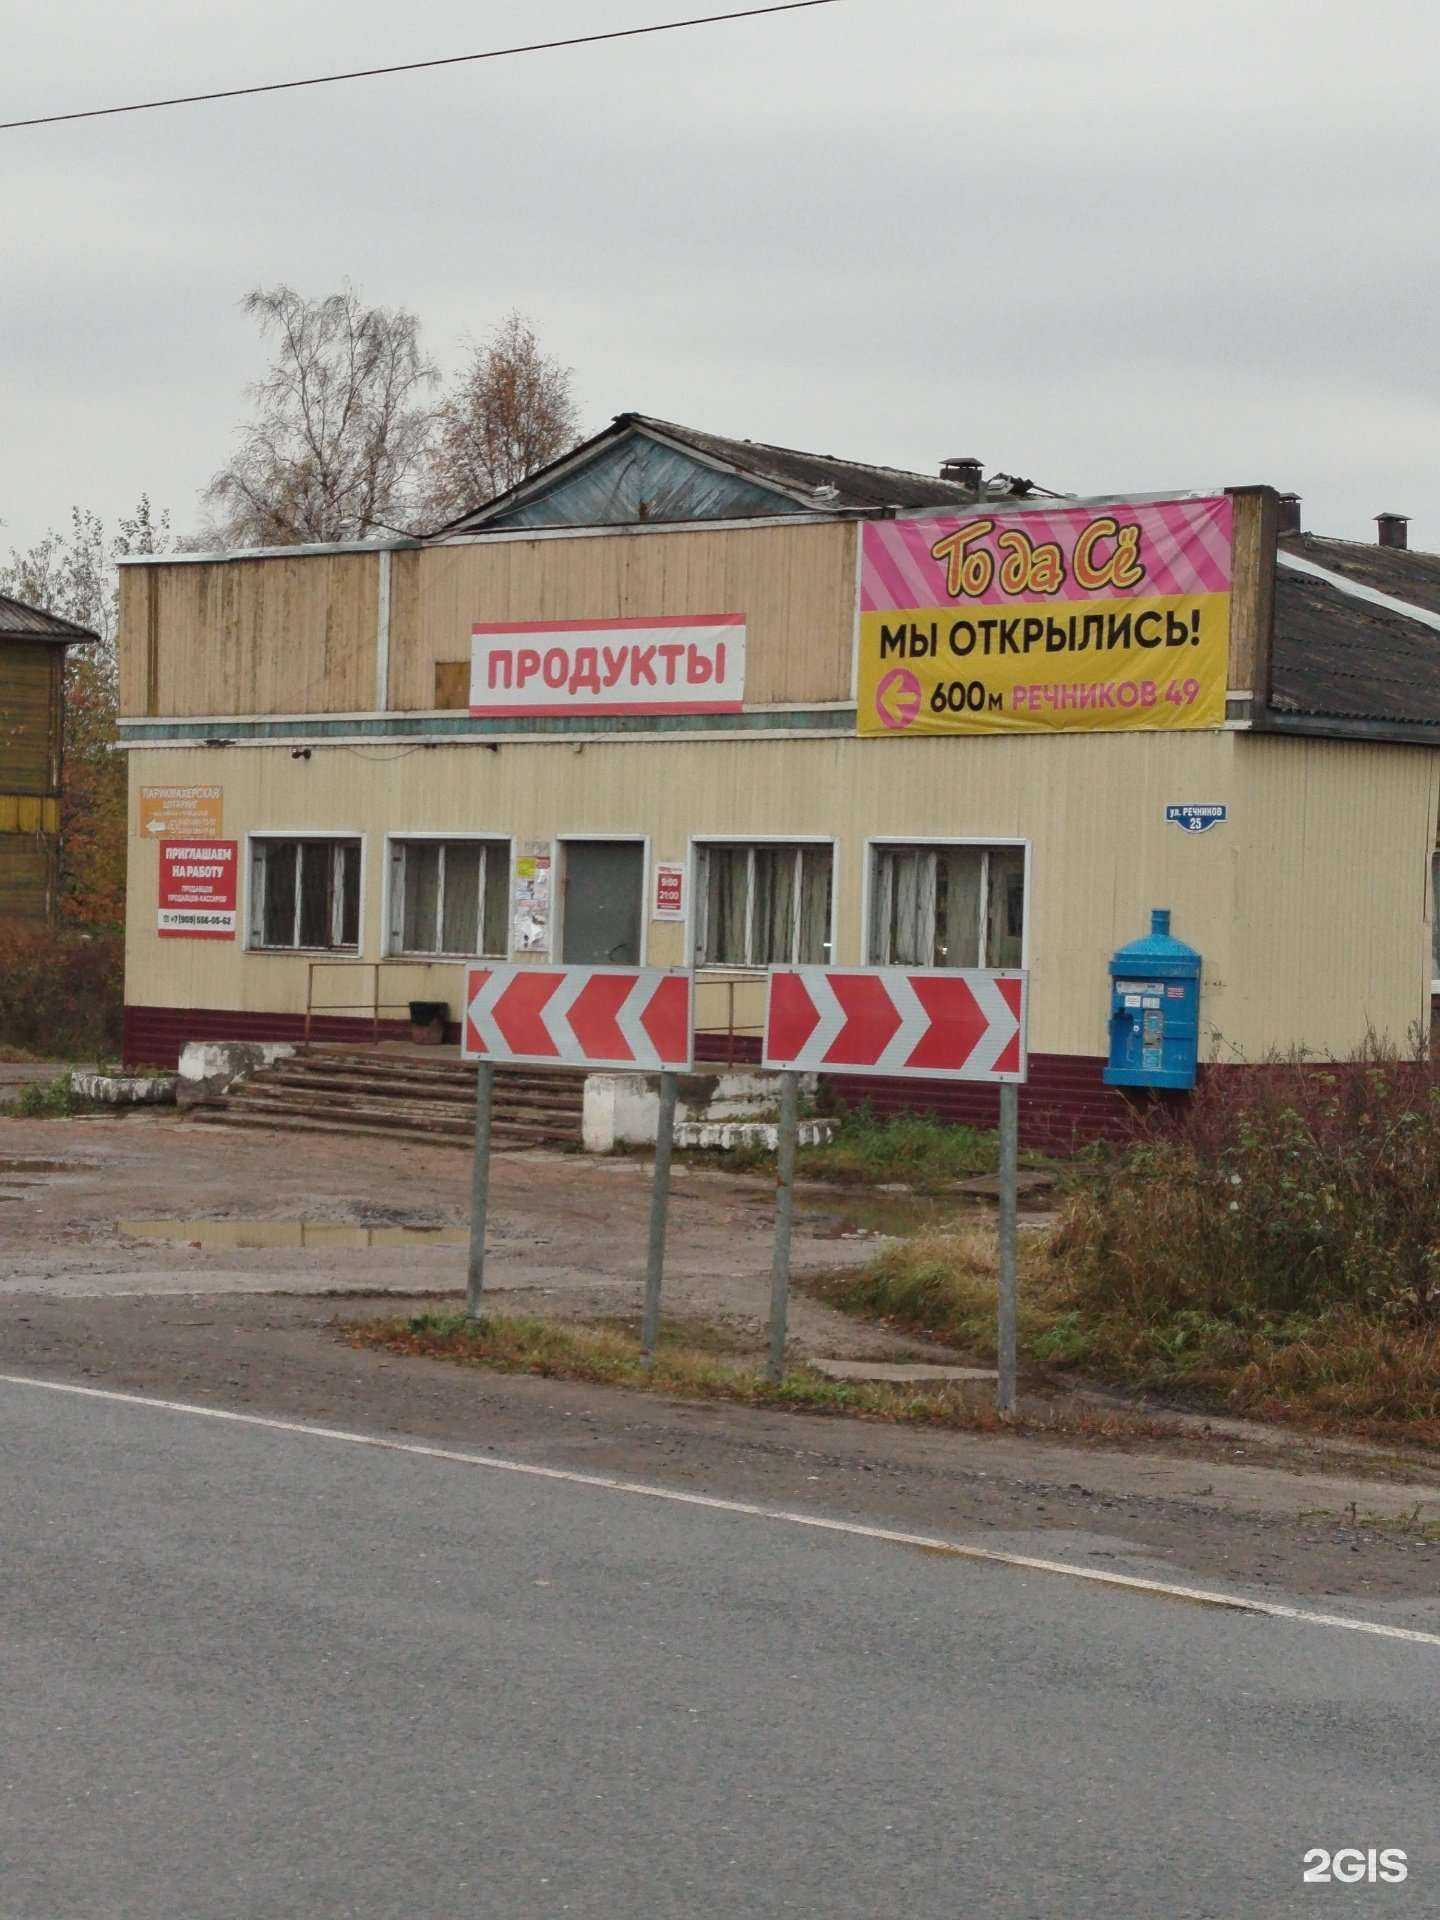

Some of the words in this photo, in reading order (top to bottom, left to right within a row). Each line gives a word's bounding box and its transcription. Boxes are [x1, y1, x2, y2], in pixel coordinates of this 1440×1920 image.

[931, 518, 994, 598] То
[998, 528, 1066, 595] да
[1072, 516, 1144, 591] Сё
[880, 623, 937, 659] МЫ
[949, 609, 1200, 656] ОТКРЫЛИСЬ!
[488, 642, 726, 695] ПРОДУКТЫ
[1012, 681, 1158, 711] РЕЧНИКОВ
[1165, 678, 1200, 705] 49
[1183, 807, 1222, 816] РЕЧНИКОВ
[1190, 817, 1202, 829] 25
[165, 848, 232, 860] ПРИГЛАШАЕМ
[172, 866, 186, 877] НА
[187, 866, 224, 878] РАБОТУ
